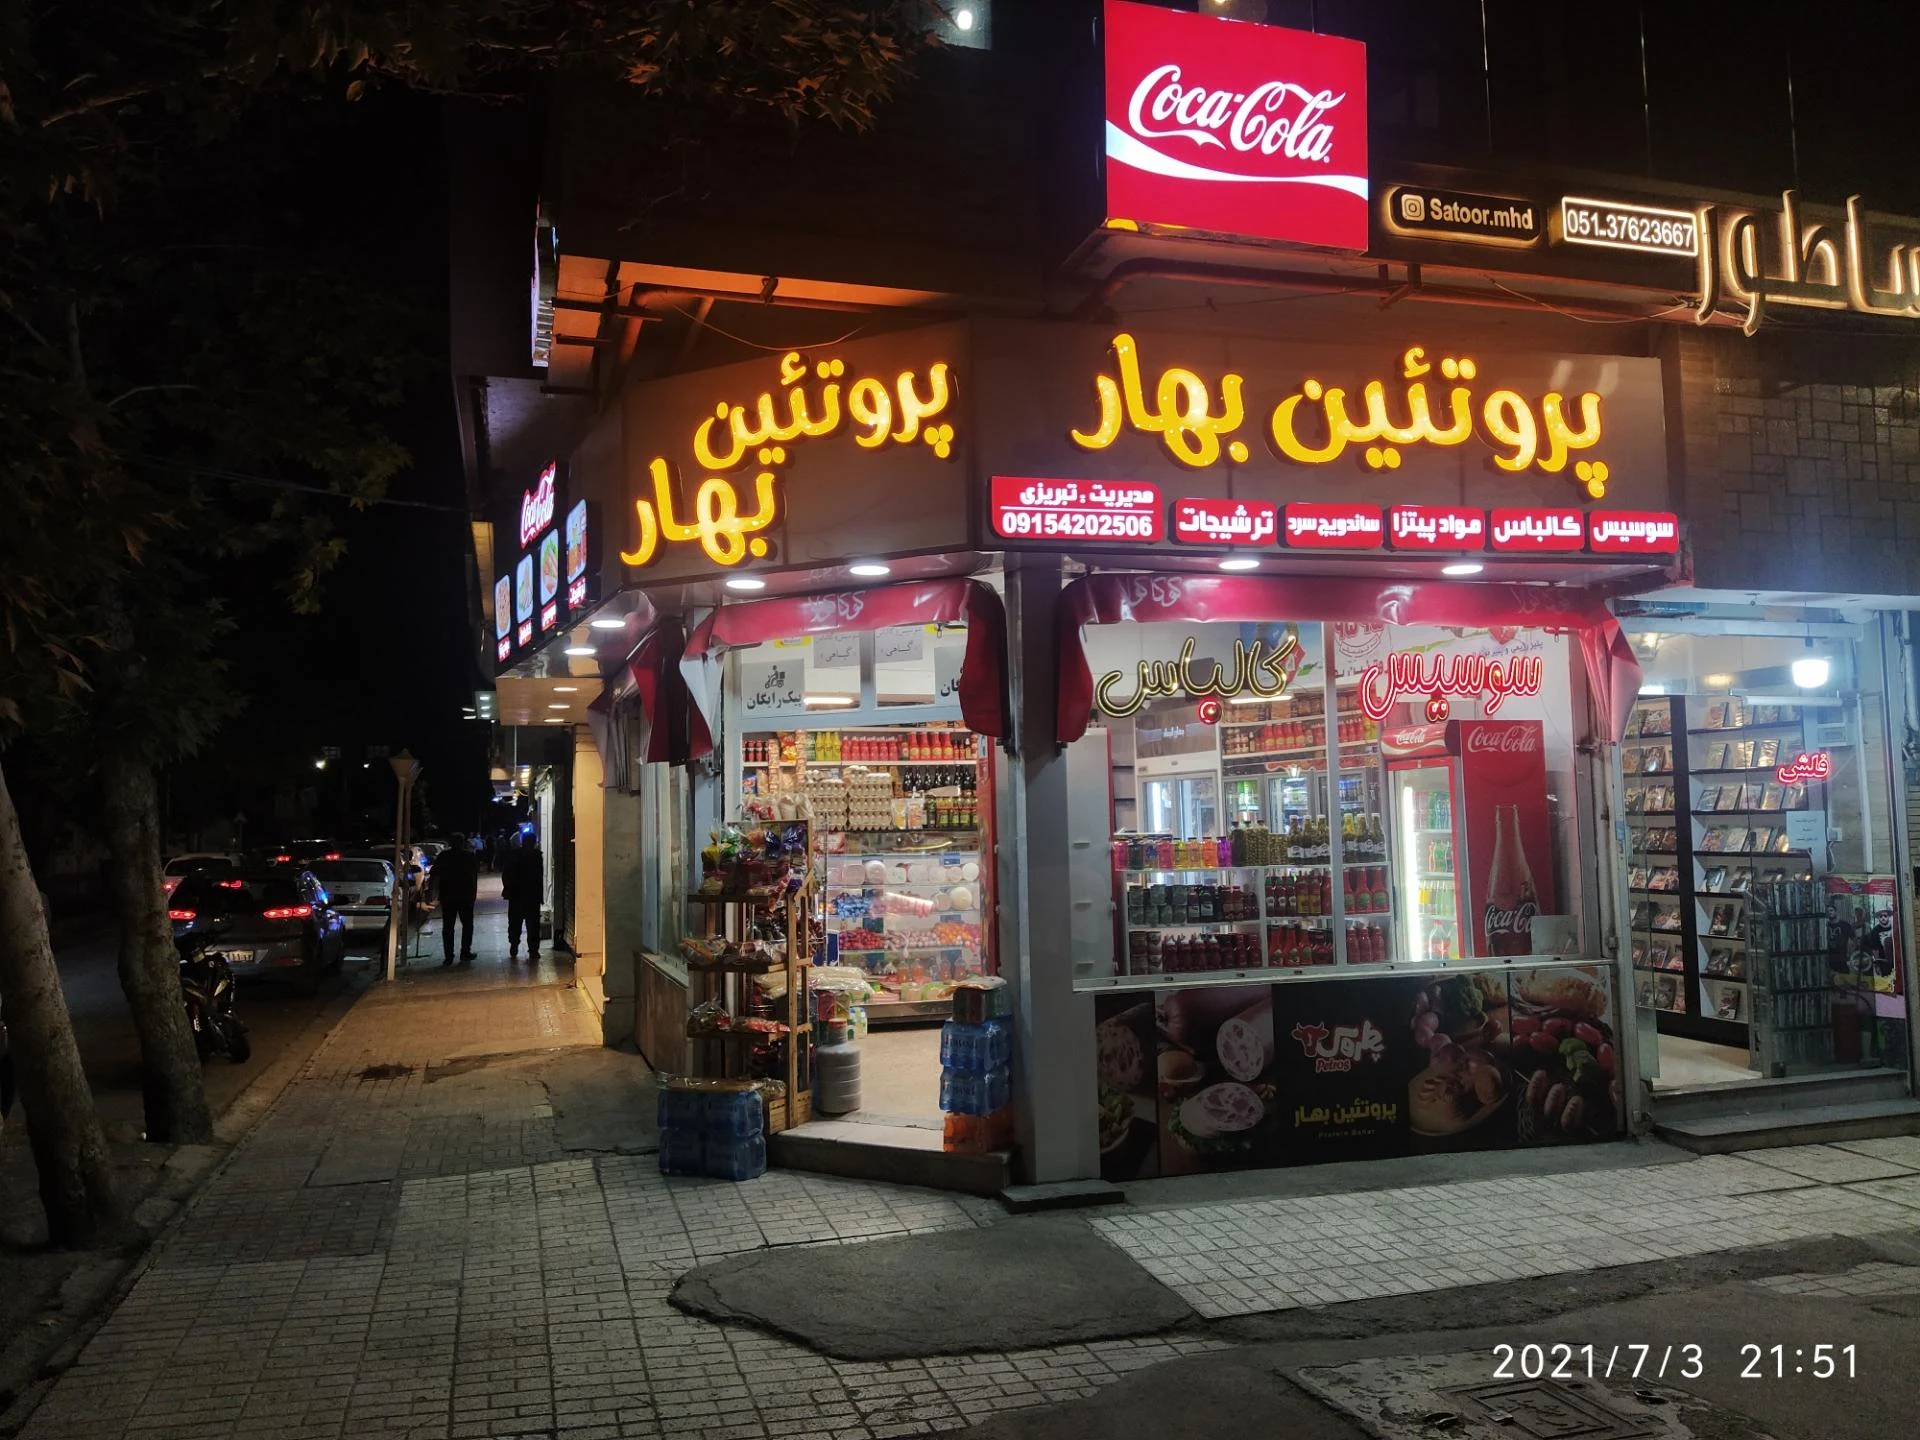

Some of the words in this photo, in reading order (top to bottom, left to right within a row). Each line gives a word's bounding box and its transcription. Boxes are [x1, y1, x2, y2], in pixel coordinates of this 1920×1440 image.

[1128, 64, 1346, 163] Coca-Cola
[1429, 198, 1534, 231] Satoor.mhd
[693, 351, 955, 469] پروتئین
[1071, 333, 1250, 467] بهار
[1271, 345, 1610, 499] پروتئین
[1019, 482, 1078, 505] تبریزی
[620, 457, 776, 566] بهار
[1002, 511, 1153, 537] 09154202506
[1178, 504, 1274, 541] ترشیجات
[1317, 513, 1380, 538] ساندویچ
[1439, 514, 1482, 536] مواد
[1287, 516, 1317, 536] سرد
[1392, 511, 1436, 543] پیتزا
[1494, 515, 1581, 543] کالباس
[1593, 519, 1674, 543] سوسیس
[1096, 635, 1297, 725] کالباس
[1360, 652, 1544, 723] سوسیس
[1468, 725, 1538, 753] Coca-Cola
[1316, 1058, 1351, 1073] Petros
[1294, 1105, 1331, 1128] بهار
[1333, 1097, 1398, 1124] پروتئین
